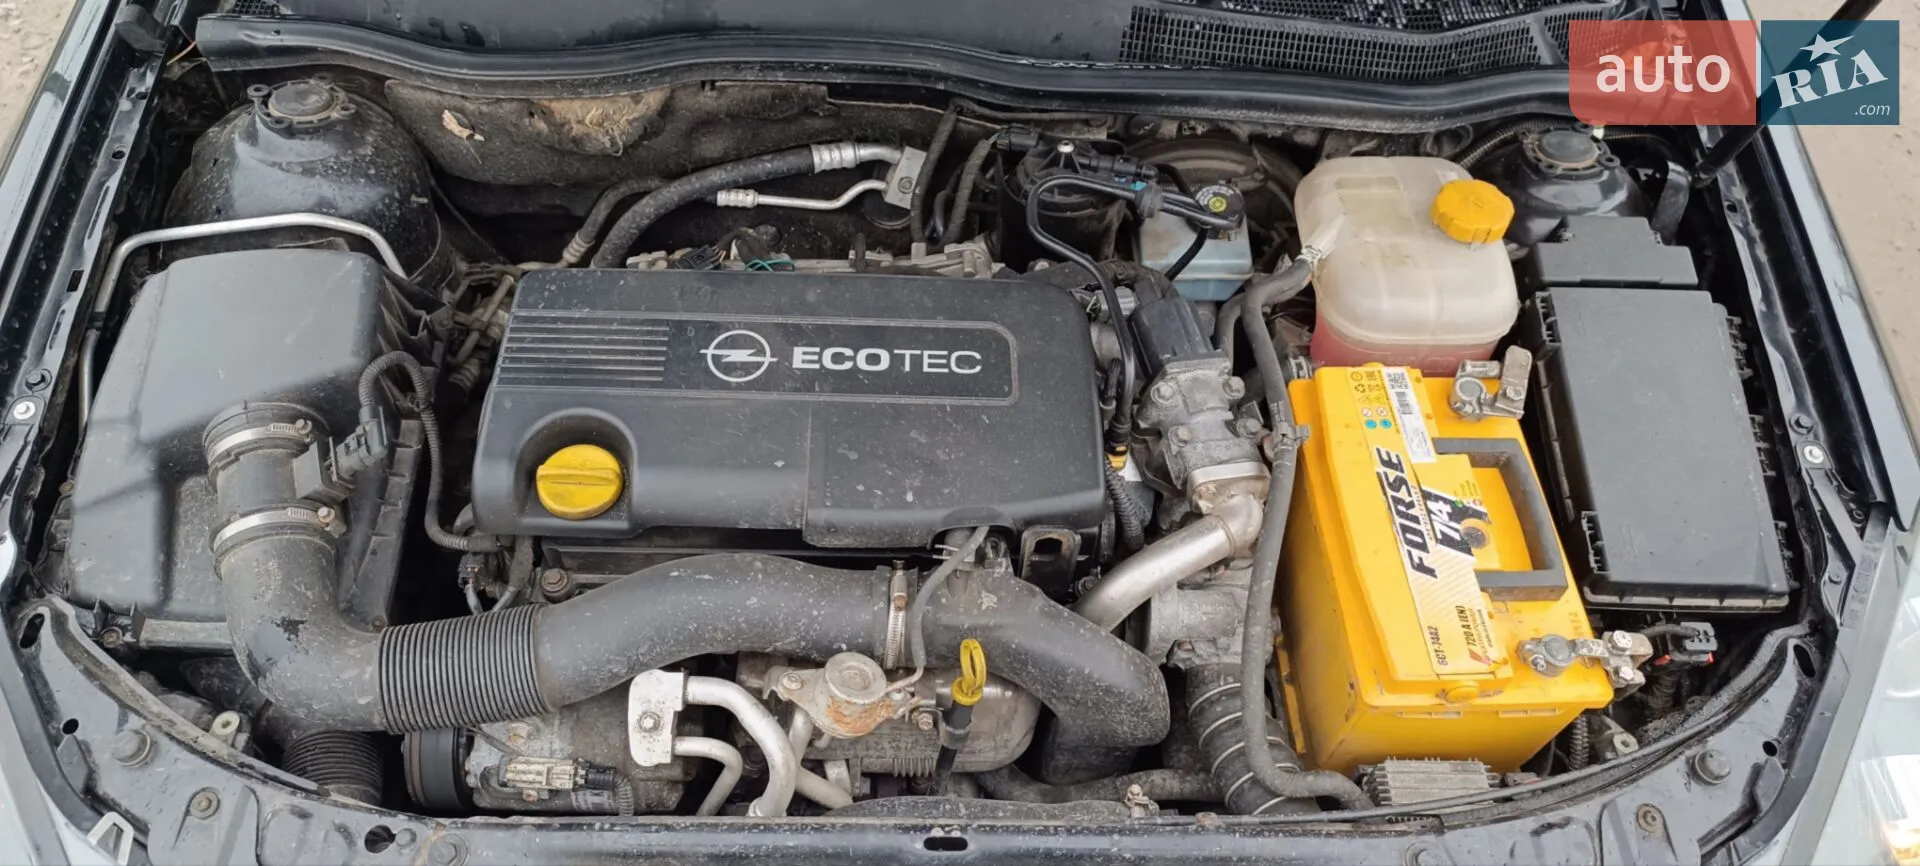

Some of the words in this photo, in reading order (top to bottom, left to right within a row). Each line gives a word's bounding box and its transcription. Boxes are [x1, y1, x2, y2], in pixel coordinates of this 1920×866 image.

[792, 346, 982, 374] ECOTEC
[1376, 447, 1438, 579] FORSE
[1426, 499, 1462, 541] 74
[1464, 631, 1477, 647] 720
